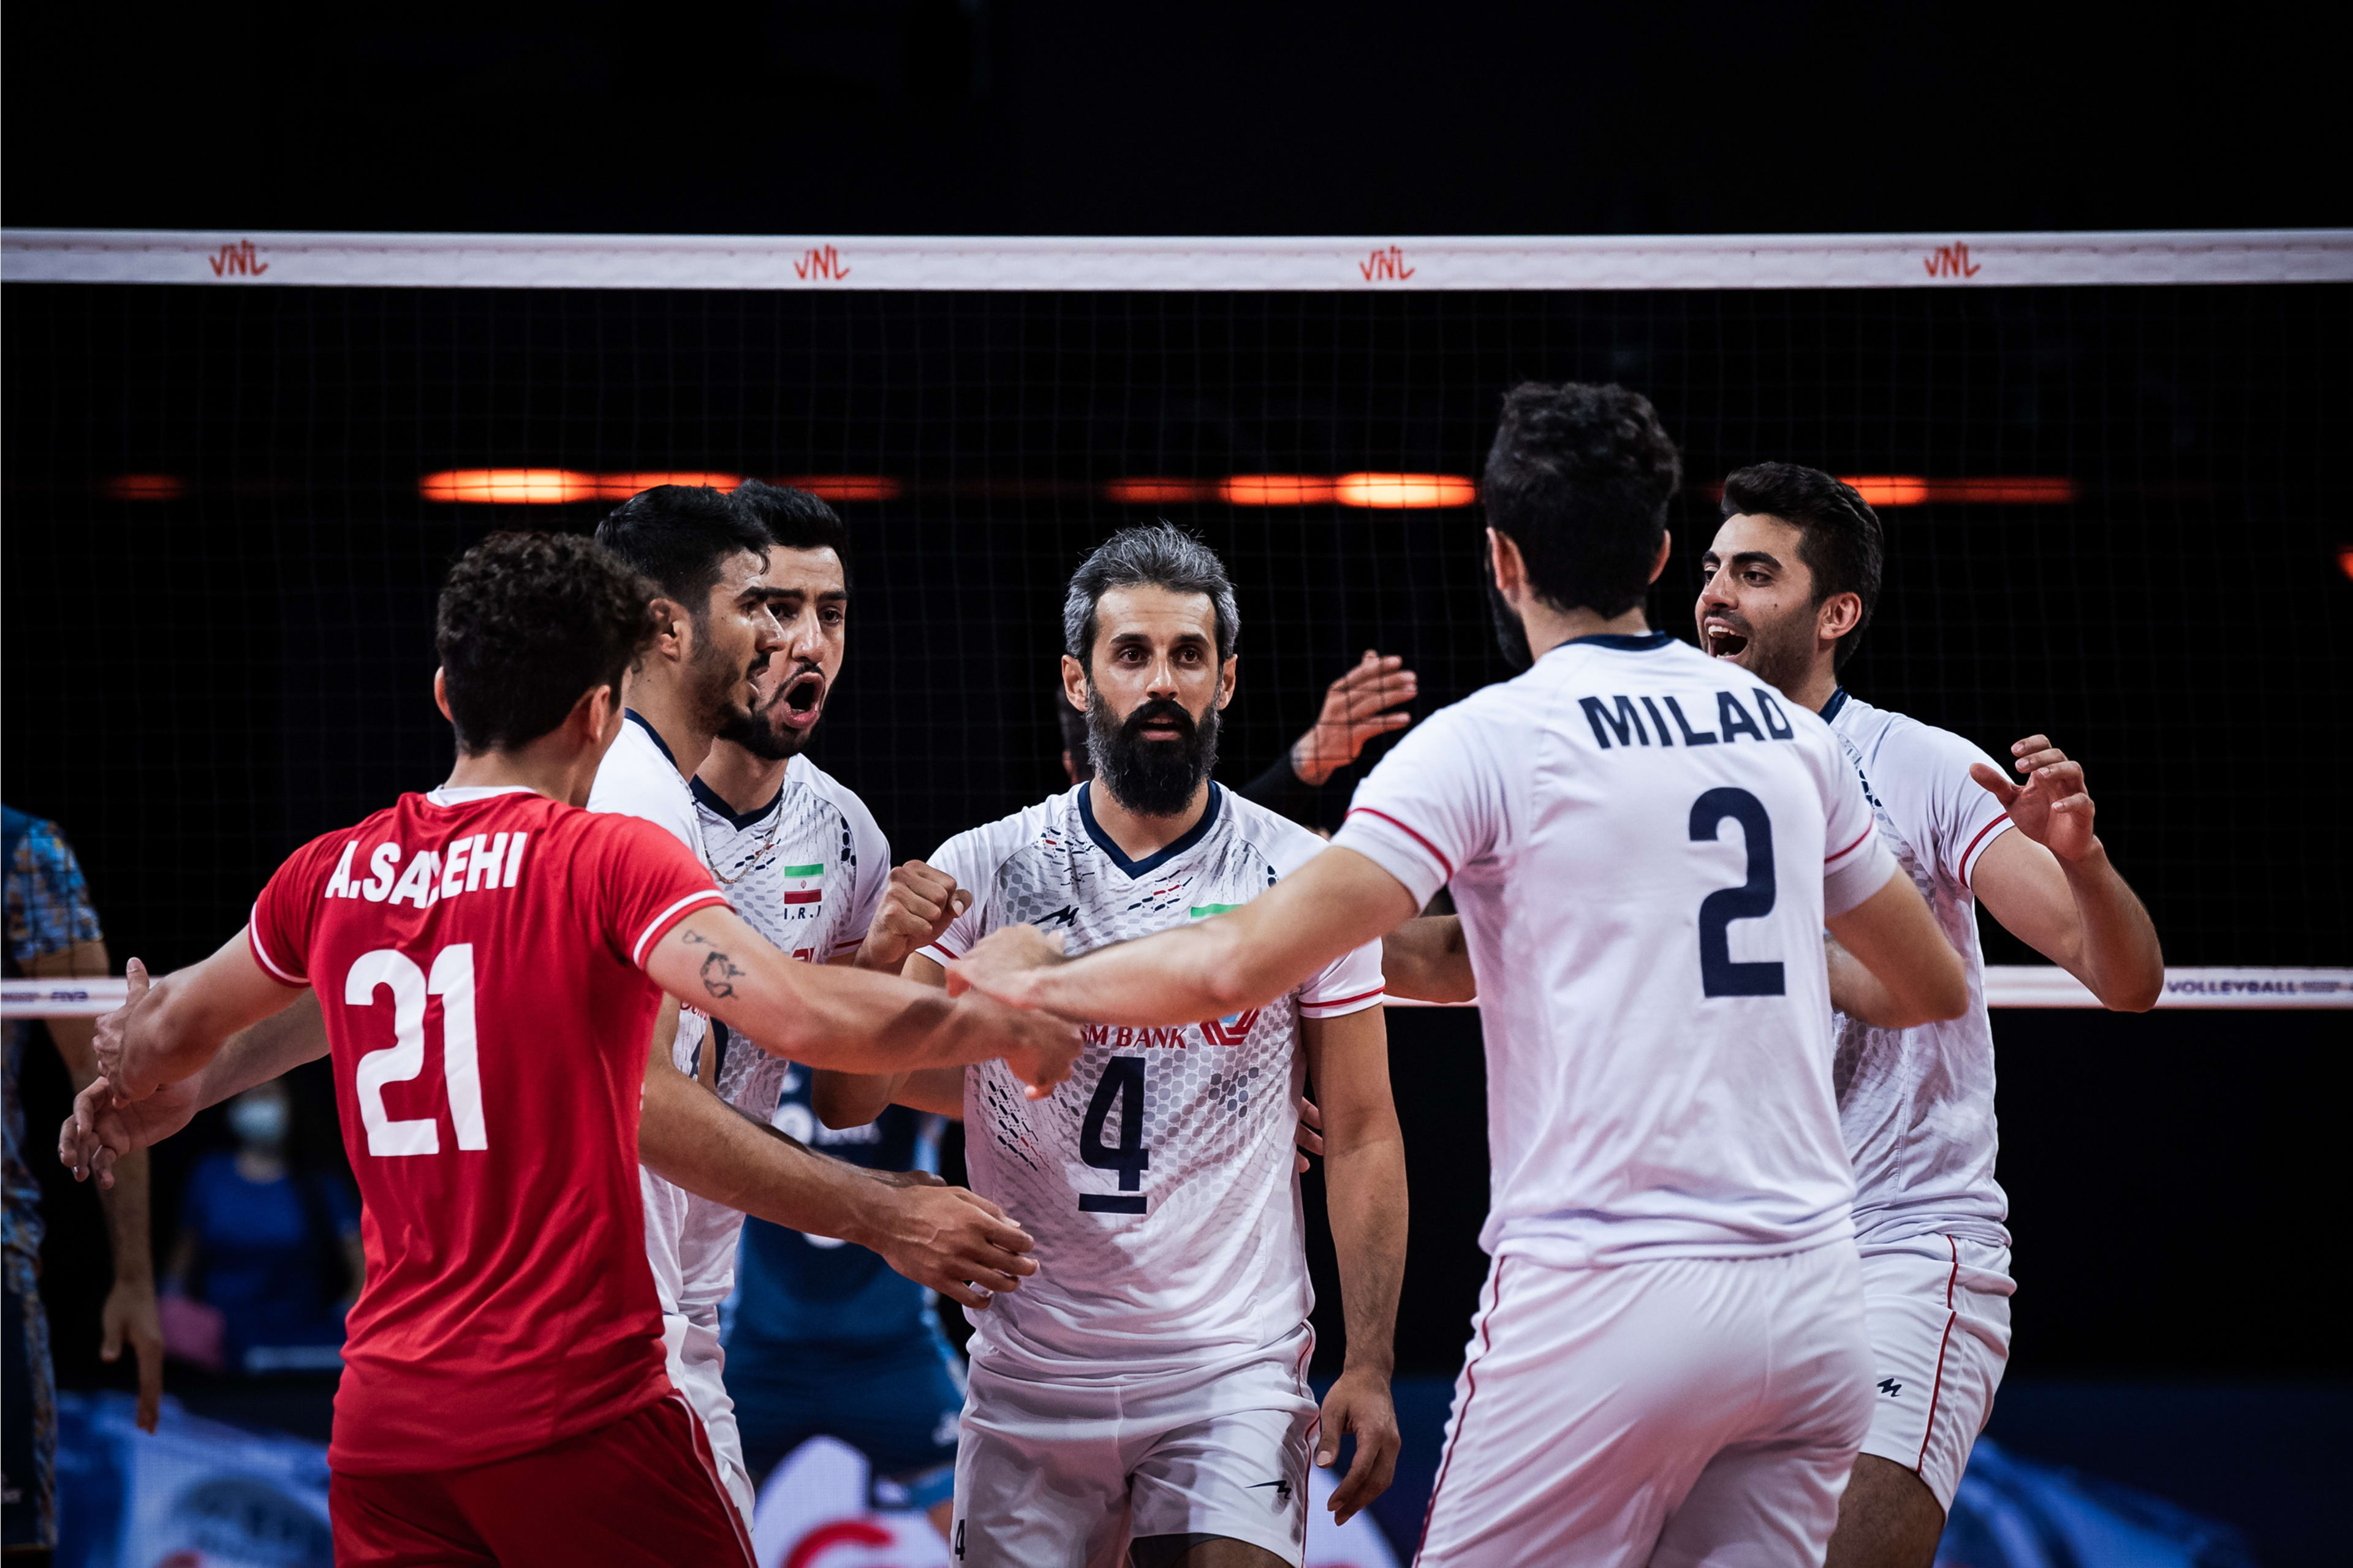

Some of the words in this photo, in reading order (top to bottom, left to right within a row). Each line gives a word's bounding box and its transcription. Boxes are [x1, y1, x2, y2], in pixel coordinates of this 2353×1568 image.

[209, 239, 268, 277] VNL
[794, 244, 850, 281] VNL
[1360, 245, 1415, 281] VNL
[1925, 241, 1980, 278] VNL
[1578, 687, 1794, 749] MILAD
[1689, 787, 1786, 998] 2
[2167, 980, 2296, 994] VOLLEYBALL
[345, 943, 488, 1157] 21
[1116, 1026, 1187, 1048] BANK
[1078, 1056, 1150, 1192] 4
[955, 1519, 965, 1561] 4
